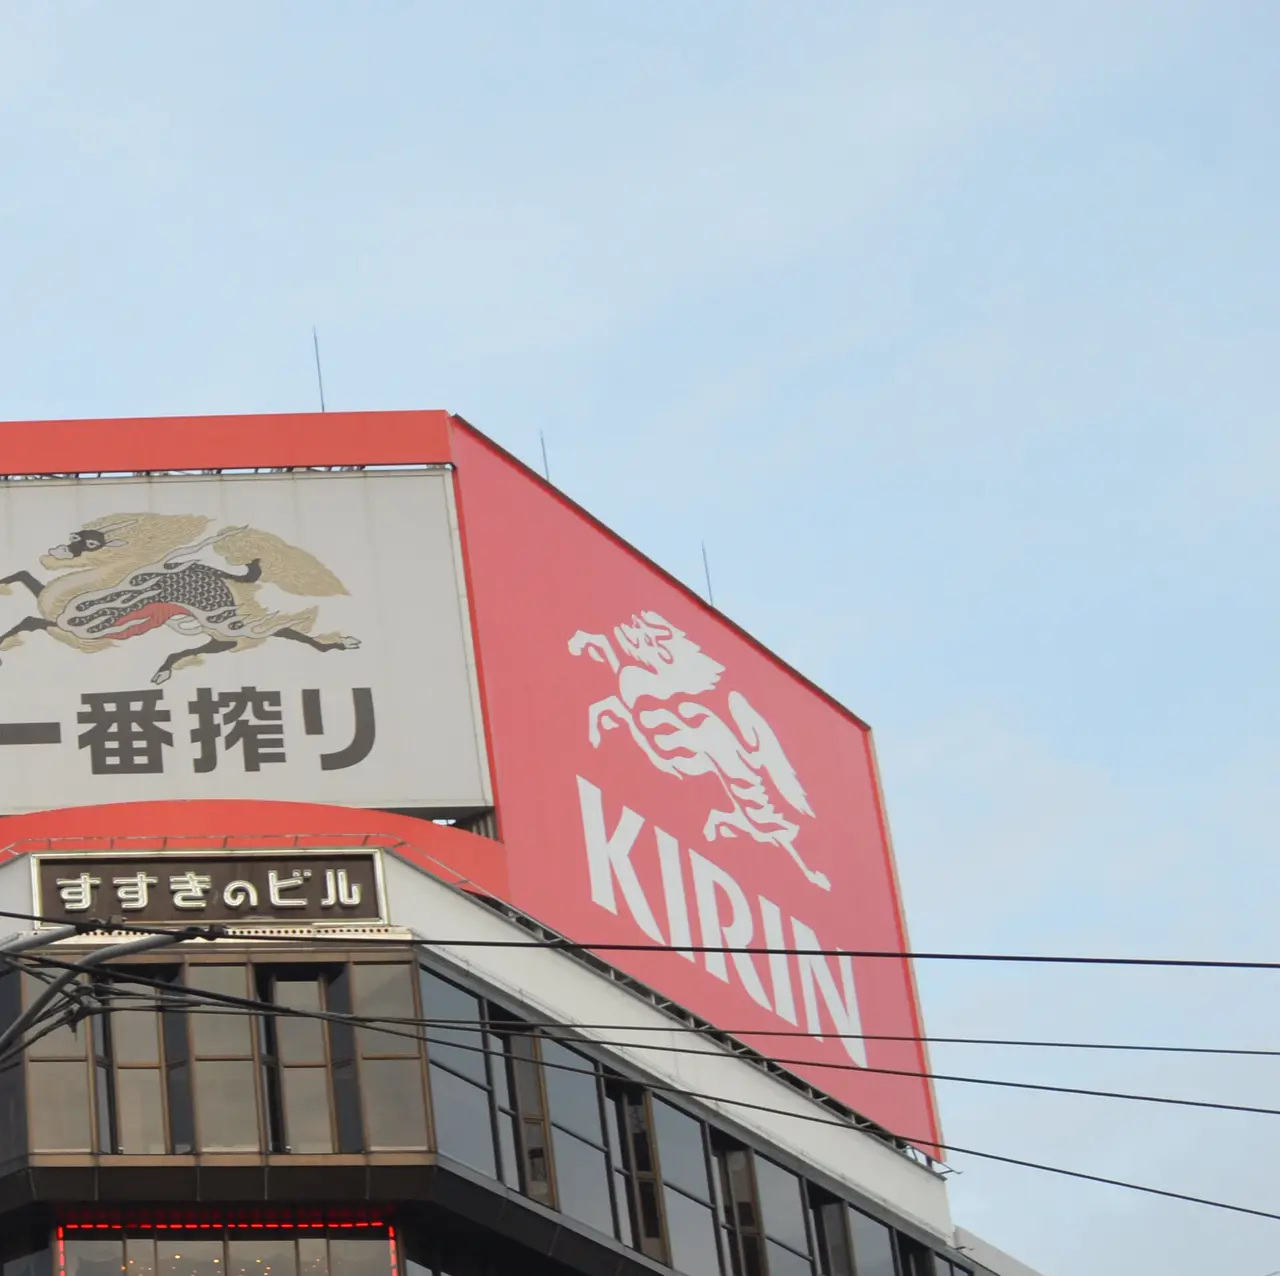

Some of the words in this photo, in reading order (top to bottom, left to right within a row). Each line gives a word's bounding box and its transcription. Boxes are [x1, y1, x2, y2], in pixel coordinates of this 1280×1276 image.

[56, 868, 362, 912] すすきのビル
[575, 773, 868, 1070] KIRIN
